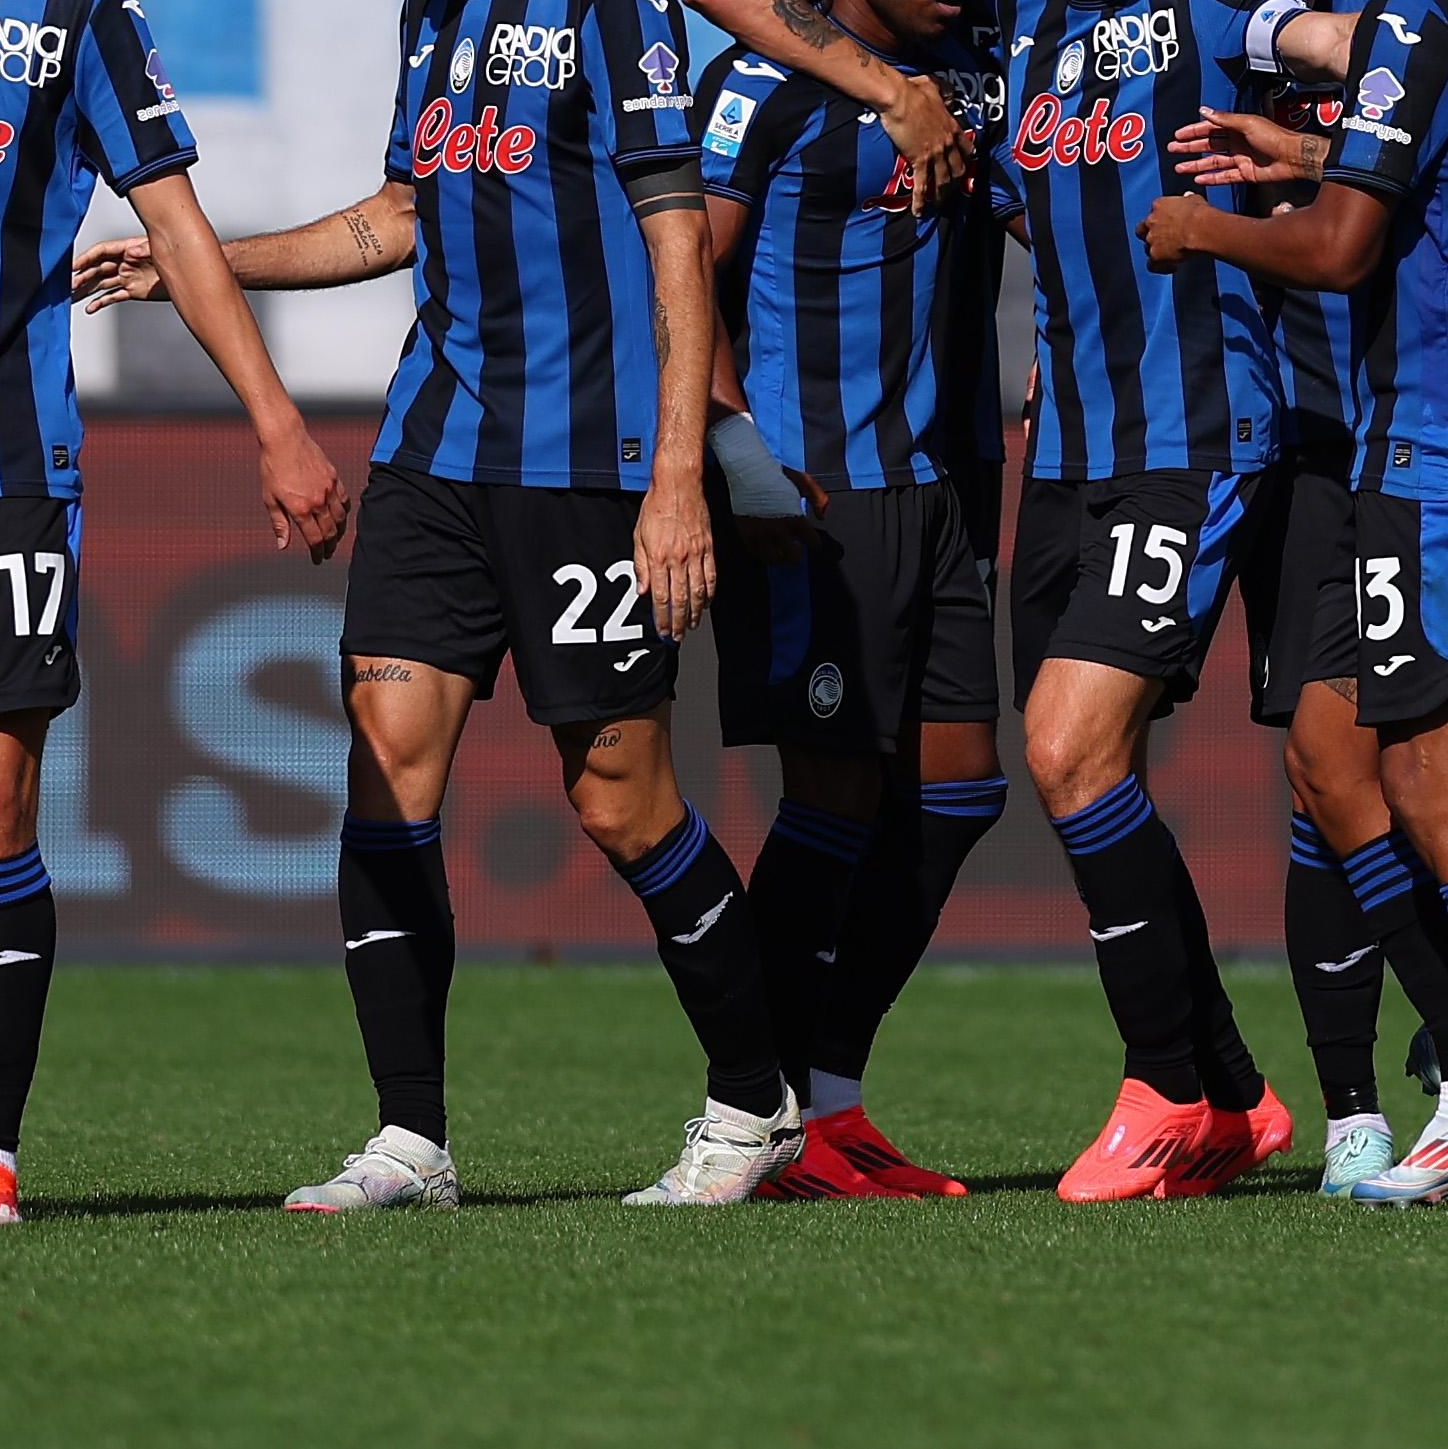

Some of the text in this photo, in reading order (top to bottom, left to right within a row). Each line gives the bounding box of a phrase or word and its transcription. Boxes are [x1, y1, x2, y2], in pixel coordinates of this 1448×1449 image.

[488, 23, 576, 60] RADICI
[1093, 9, 1178, 53] RADICI
[485, 53, 577, 91] GROUP
[1094, 35, 1180, 82] GROUP
[412, 97, 536, 179] Lete
[1012, 93, 1146, 171] Lete
[1107, 522, 1189, 605] 15
[552, 561, 644, 644] 22
[355, 663, 413, 683] abella
